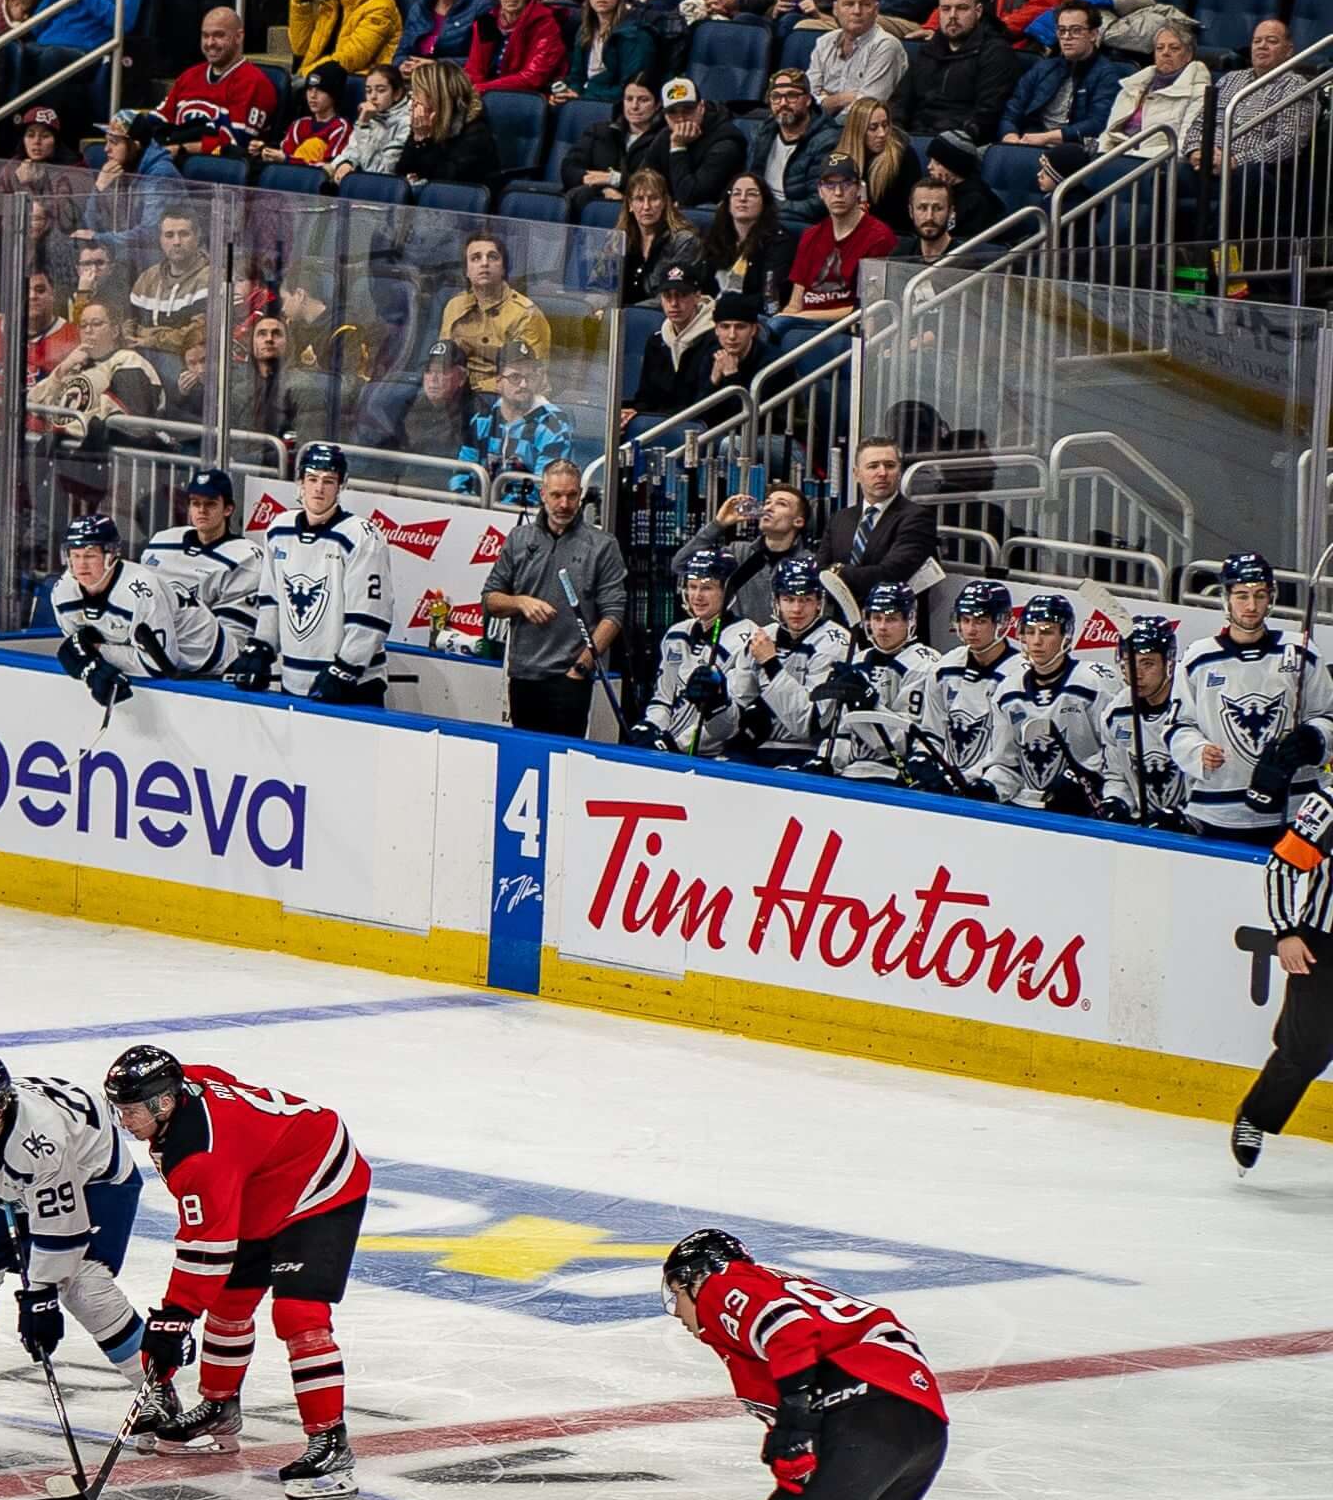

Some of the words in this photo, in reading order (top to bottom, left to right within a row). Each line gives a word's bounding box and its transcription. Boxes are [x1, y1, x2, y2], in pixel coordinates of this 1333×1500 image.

[247, 106, 268, 128] 83
[502, 768, 541, 858] 4
[585, 799, 735, 951] Tim
[747, 815, 1088, 1008] Hortons
[35, 1181, 76, 1219] 29
[180, 1193, 204, 1227] 8
[148, 1320, 192, 1332] CCM
[719, 1287, 750, 1342] 83
